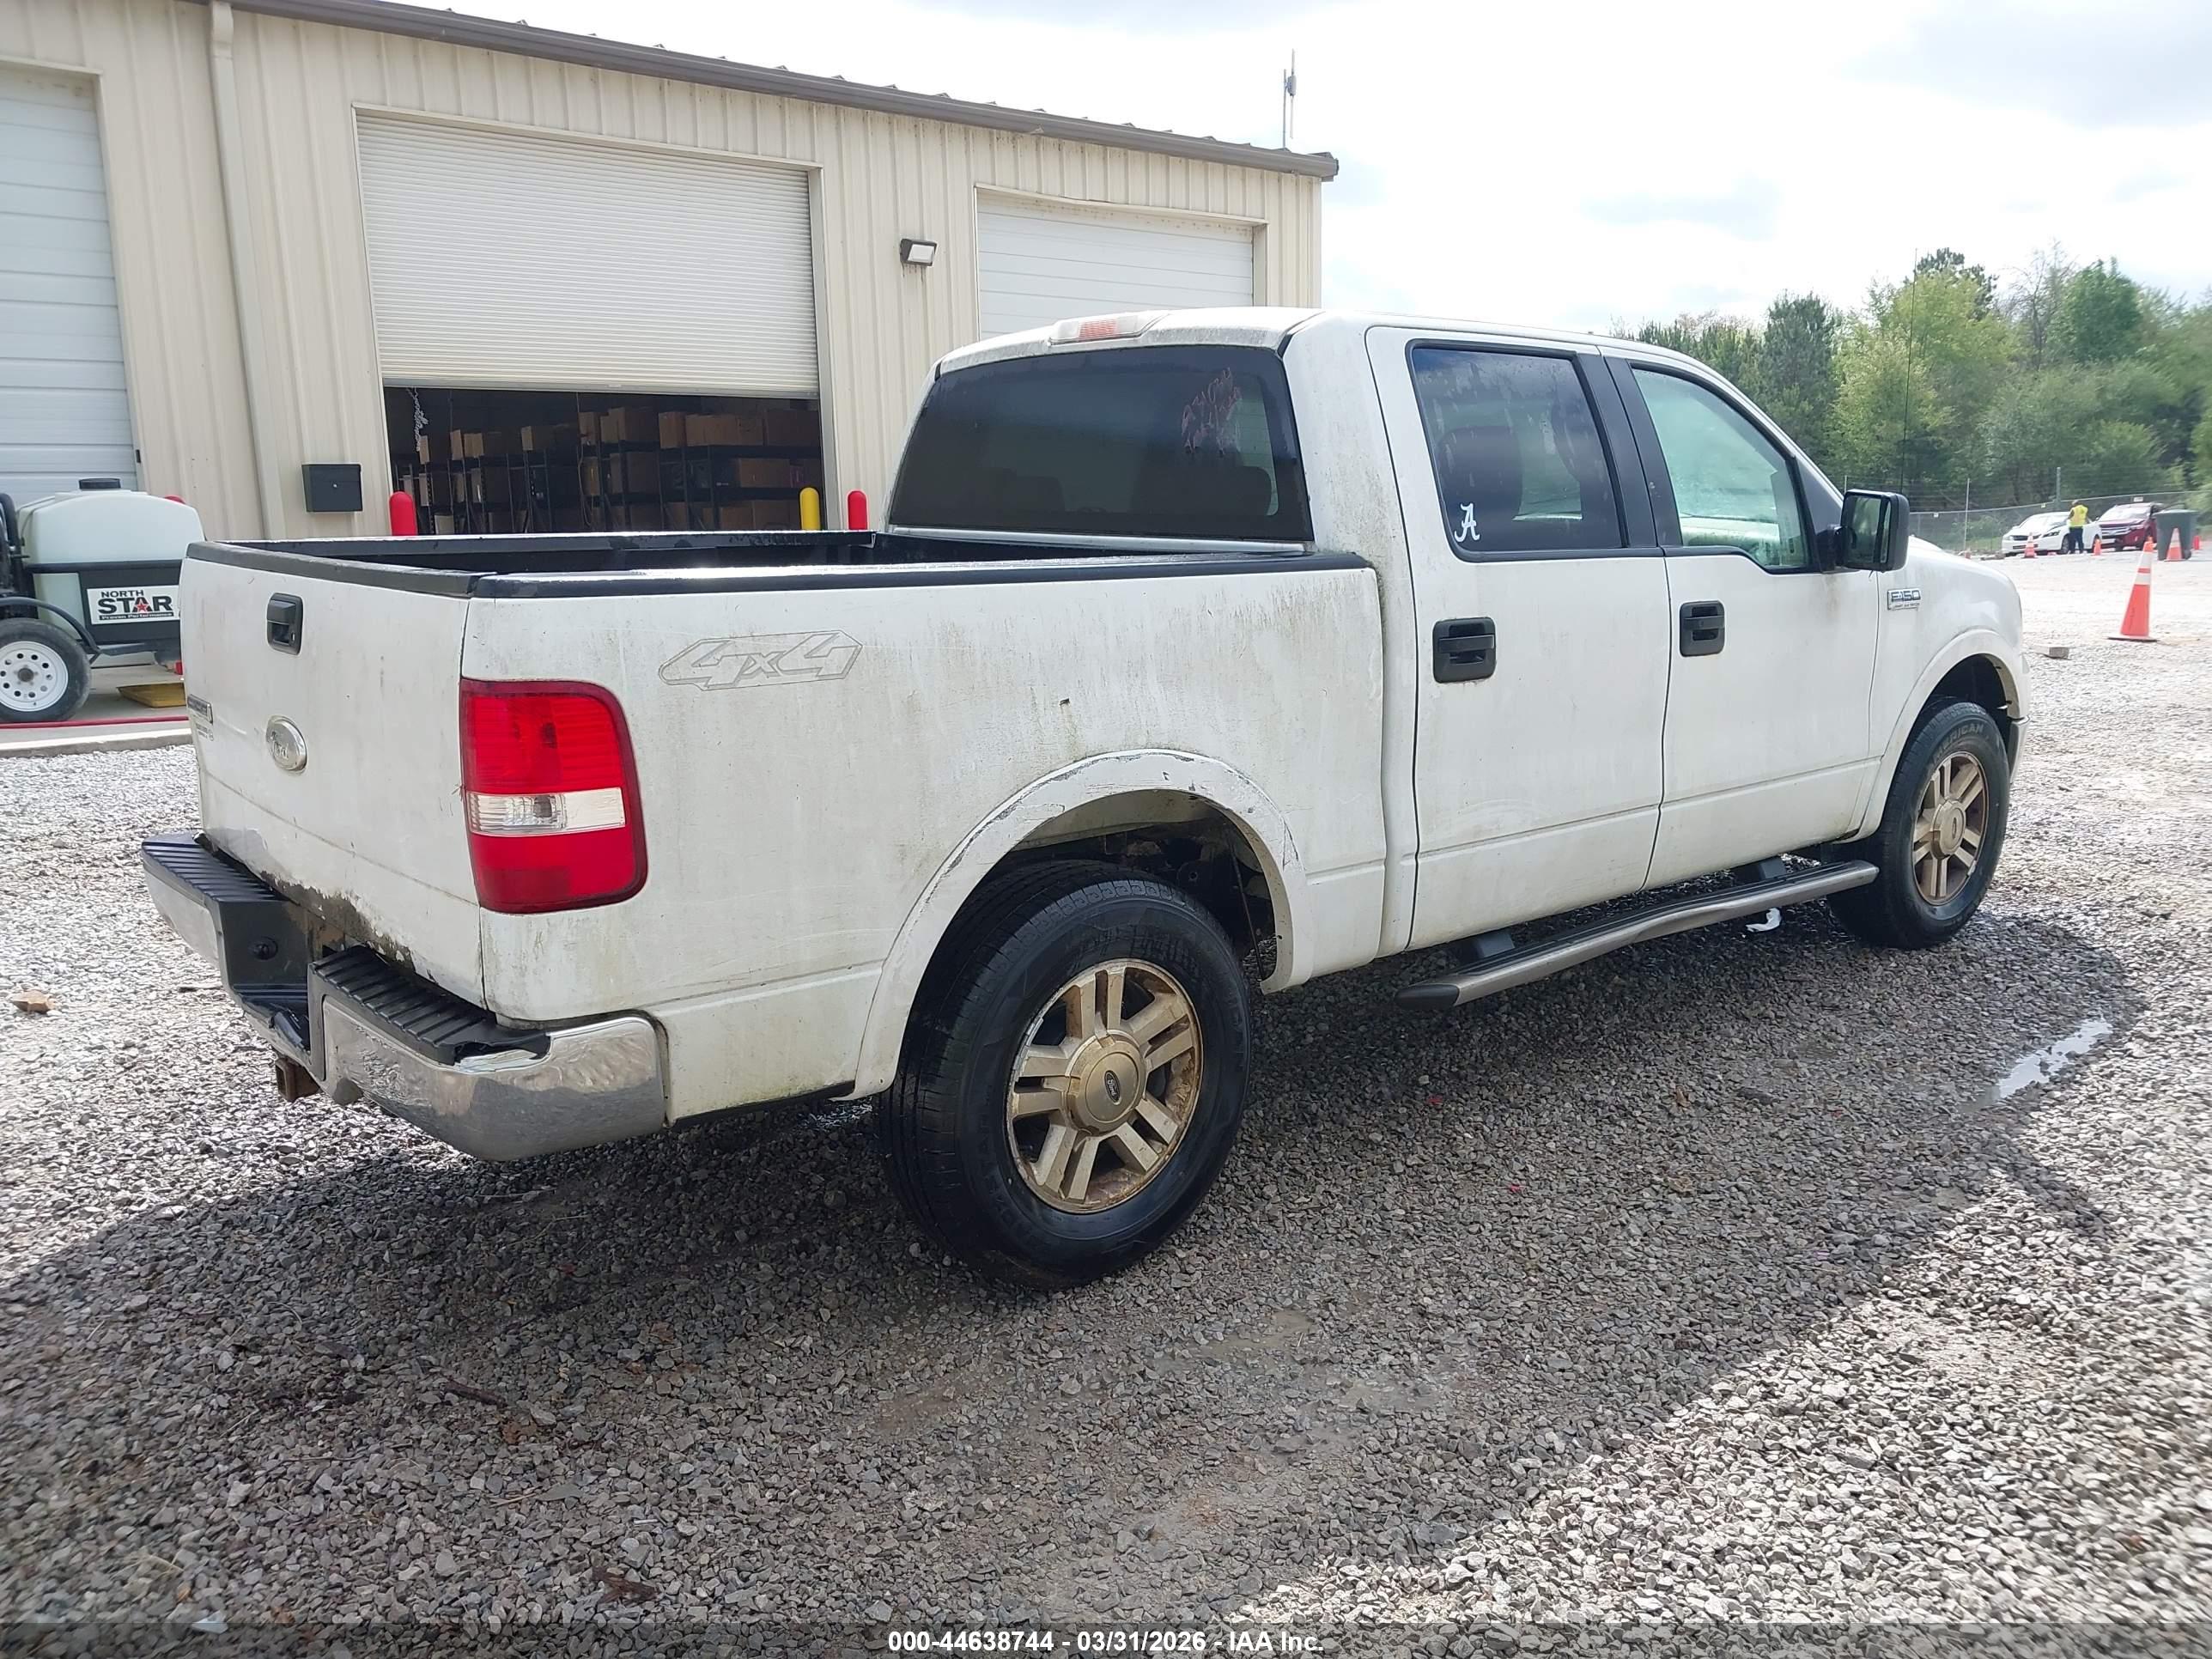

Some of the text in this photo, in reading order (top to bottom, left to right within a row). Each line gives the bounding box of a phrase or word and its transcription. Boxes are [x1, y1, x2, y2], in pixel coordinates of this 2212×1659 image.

[1454, 502, 1480, 543] A
[100, 589, 144, 599] NORTH
[97, 595, 173, 615] STAR
